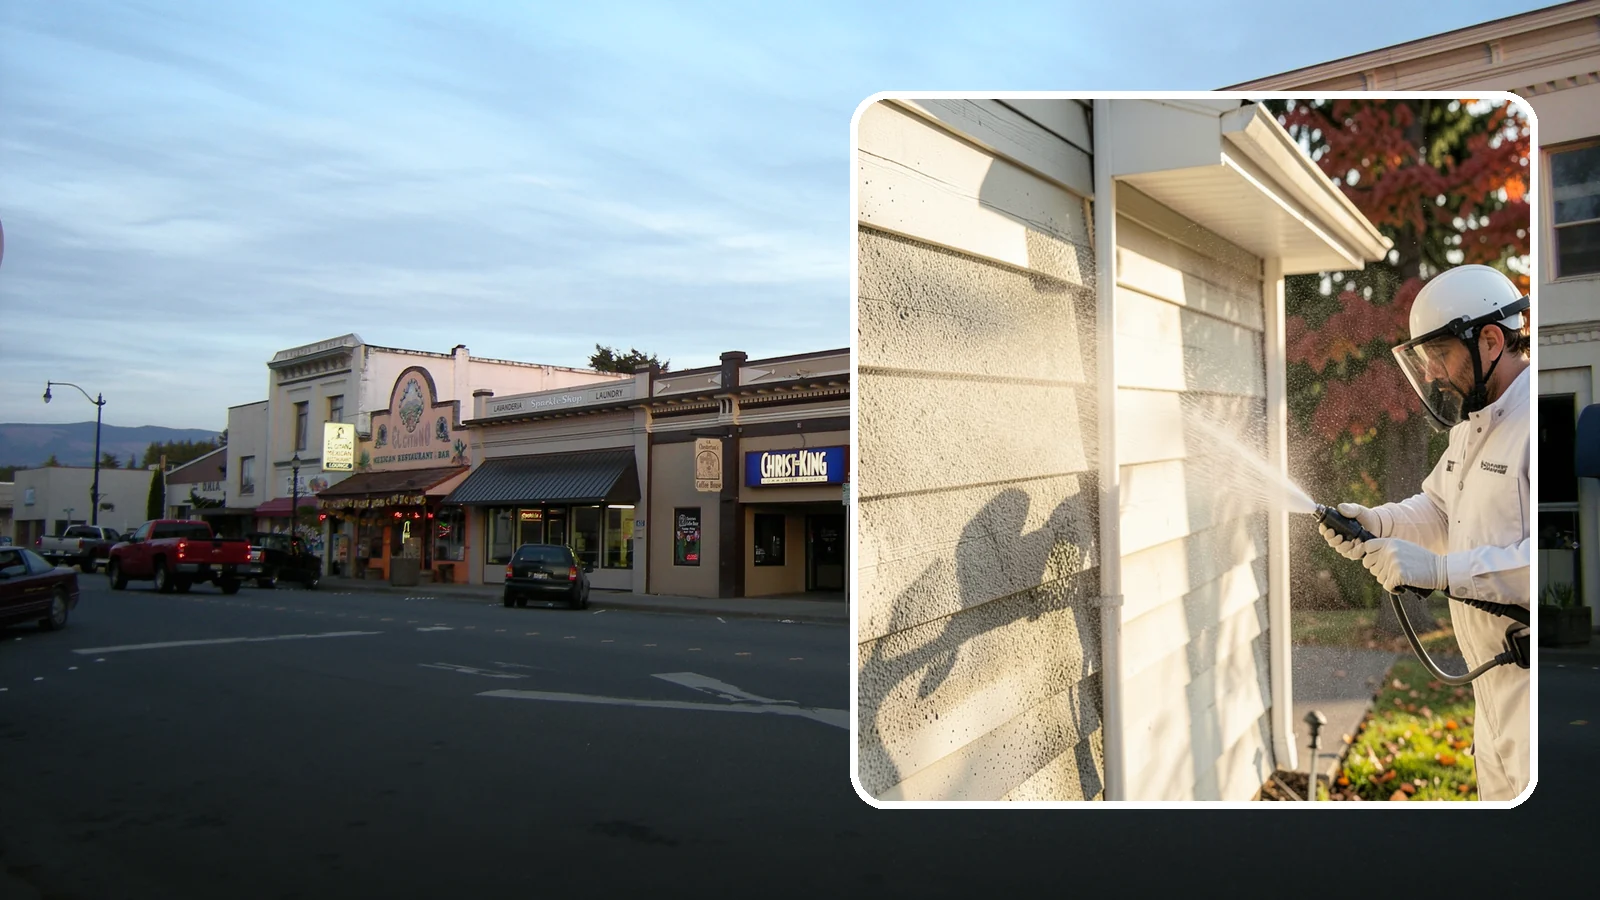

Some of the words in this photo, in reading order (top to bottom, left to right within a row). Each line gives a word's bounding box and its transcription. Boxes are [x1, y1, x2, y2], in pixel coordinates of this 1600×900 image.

[595, 389, 624, 400] LAUNDRY
[493, 402, 522, 413] LAVANDERIA
[397, 451, 433, 462] RESTAURANT
[437, 450, 450, 459] BAR
[761, 452, 797, 478] CHRIST
[799, 450, 827, 476] KING
